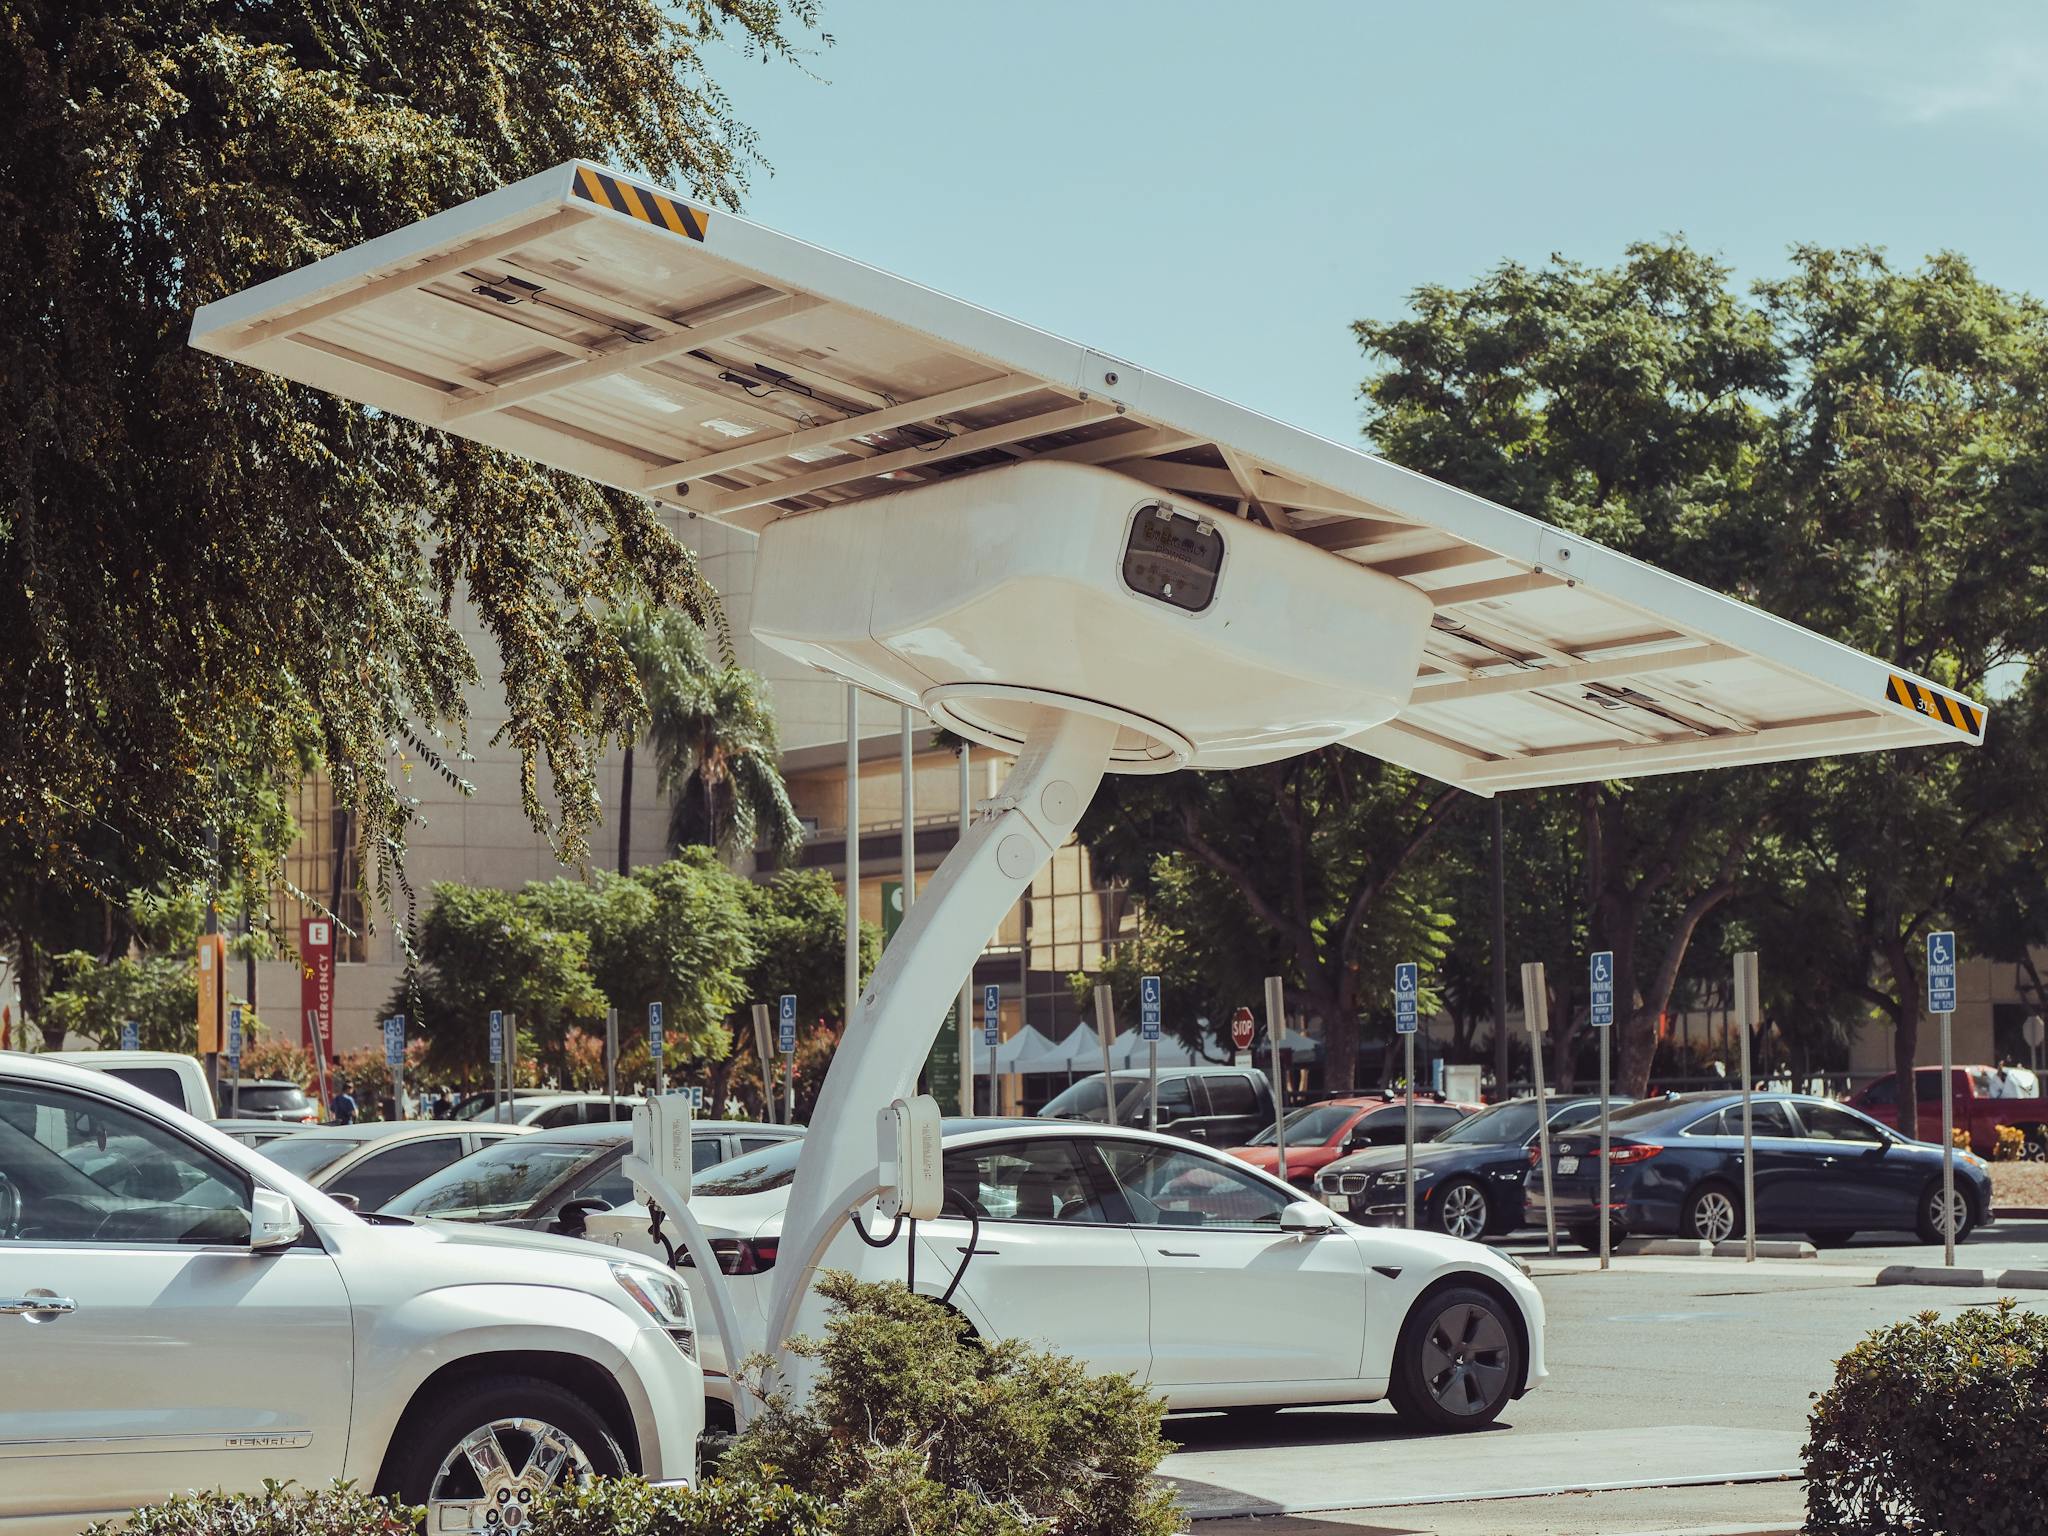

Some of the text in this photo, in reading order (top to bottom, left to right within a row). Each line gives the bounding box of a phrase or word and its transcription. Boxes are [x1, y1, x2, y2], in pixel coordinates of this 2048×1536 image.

[1917, 698, 1935, 714] 315
[1315, 927, 1323, 941] E
[1931, 964, 1953, 976] PARKING
[1592, 981, 1611, 993] PARKING
[1935, 977, 1949, 988] ONLY
[318, 954, 329, 1040] EMERGENCY
[1596, 993, 1608, 1003] ONLY
[1233, 1020, 1252, 1036] STOP
